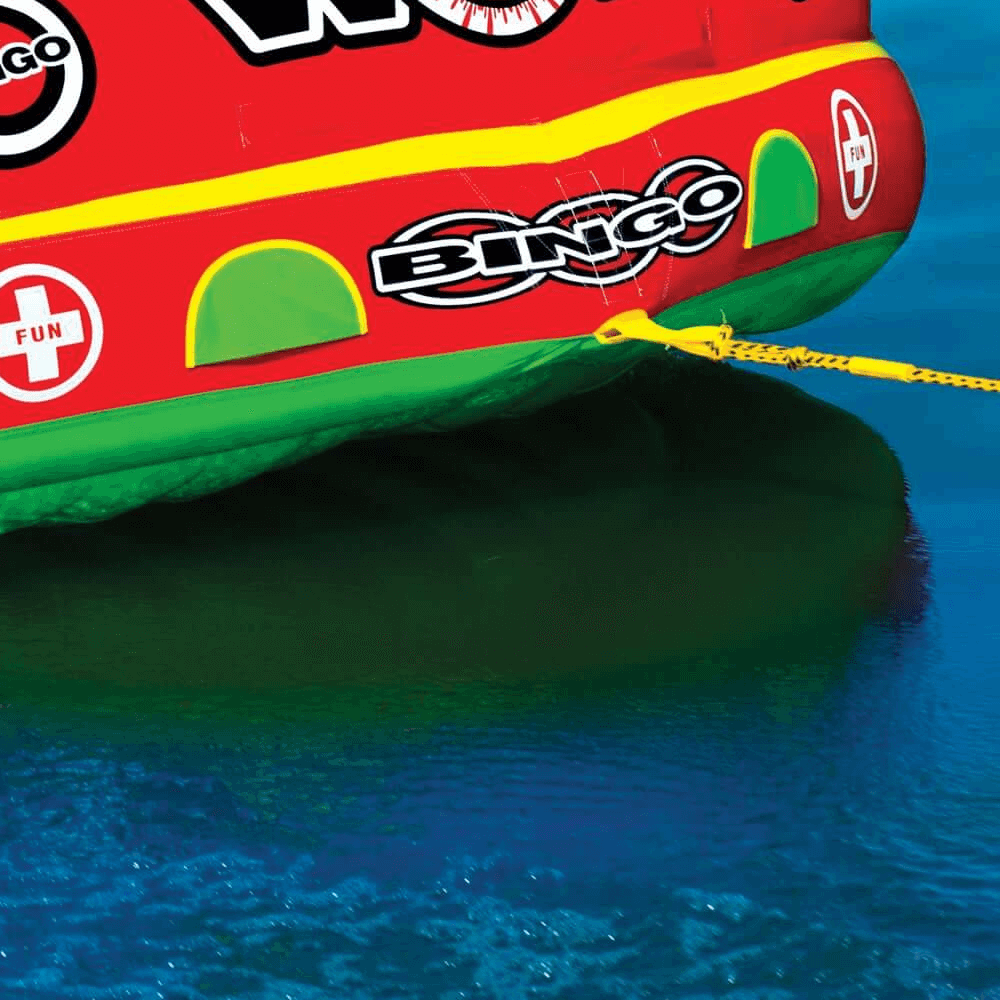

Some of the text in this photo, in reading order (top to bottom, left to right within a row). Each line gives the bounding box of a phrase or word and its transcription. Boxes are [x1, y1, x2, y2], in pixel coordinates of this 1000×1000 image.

[850, 144, 866, 162] FUN
[371, 174, 744, 293] BINGO
[15, 321, 62, 345] FUN
